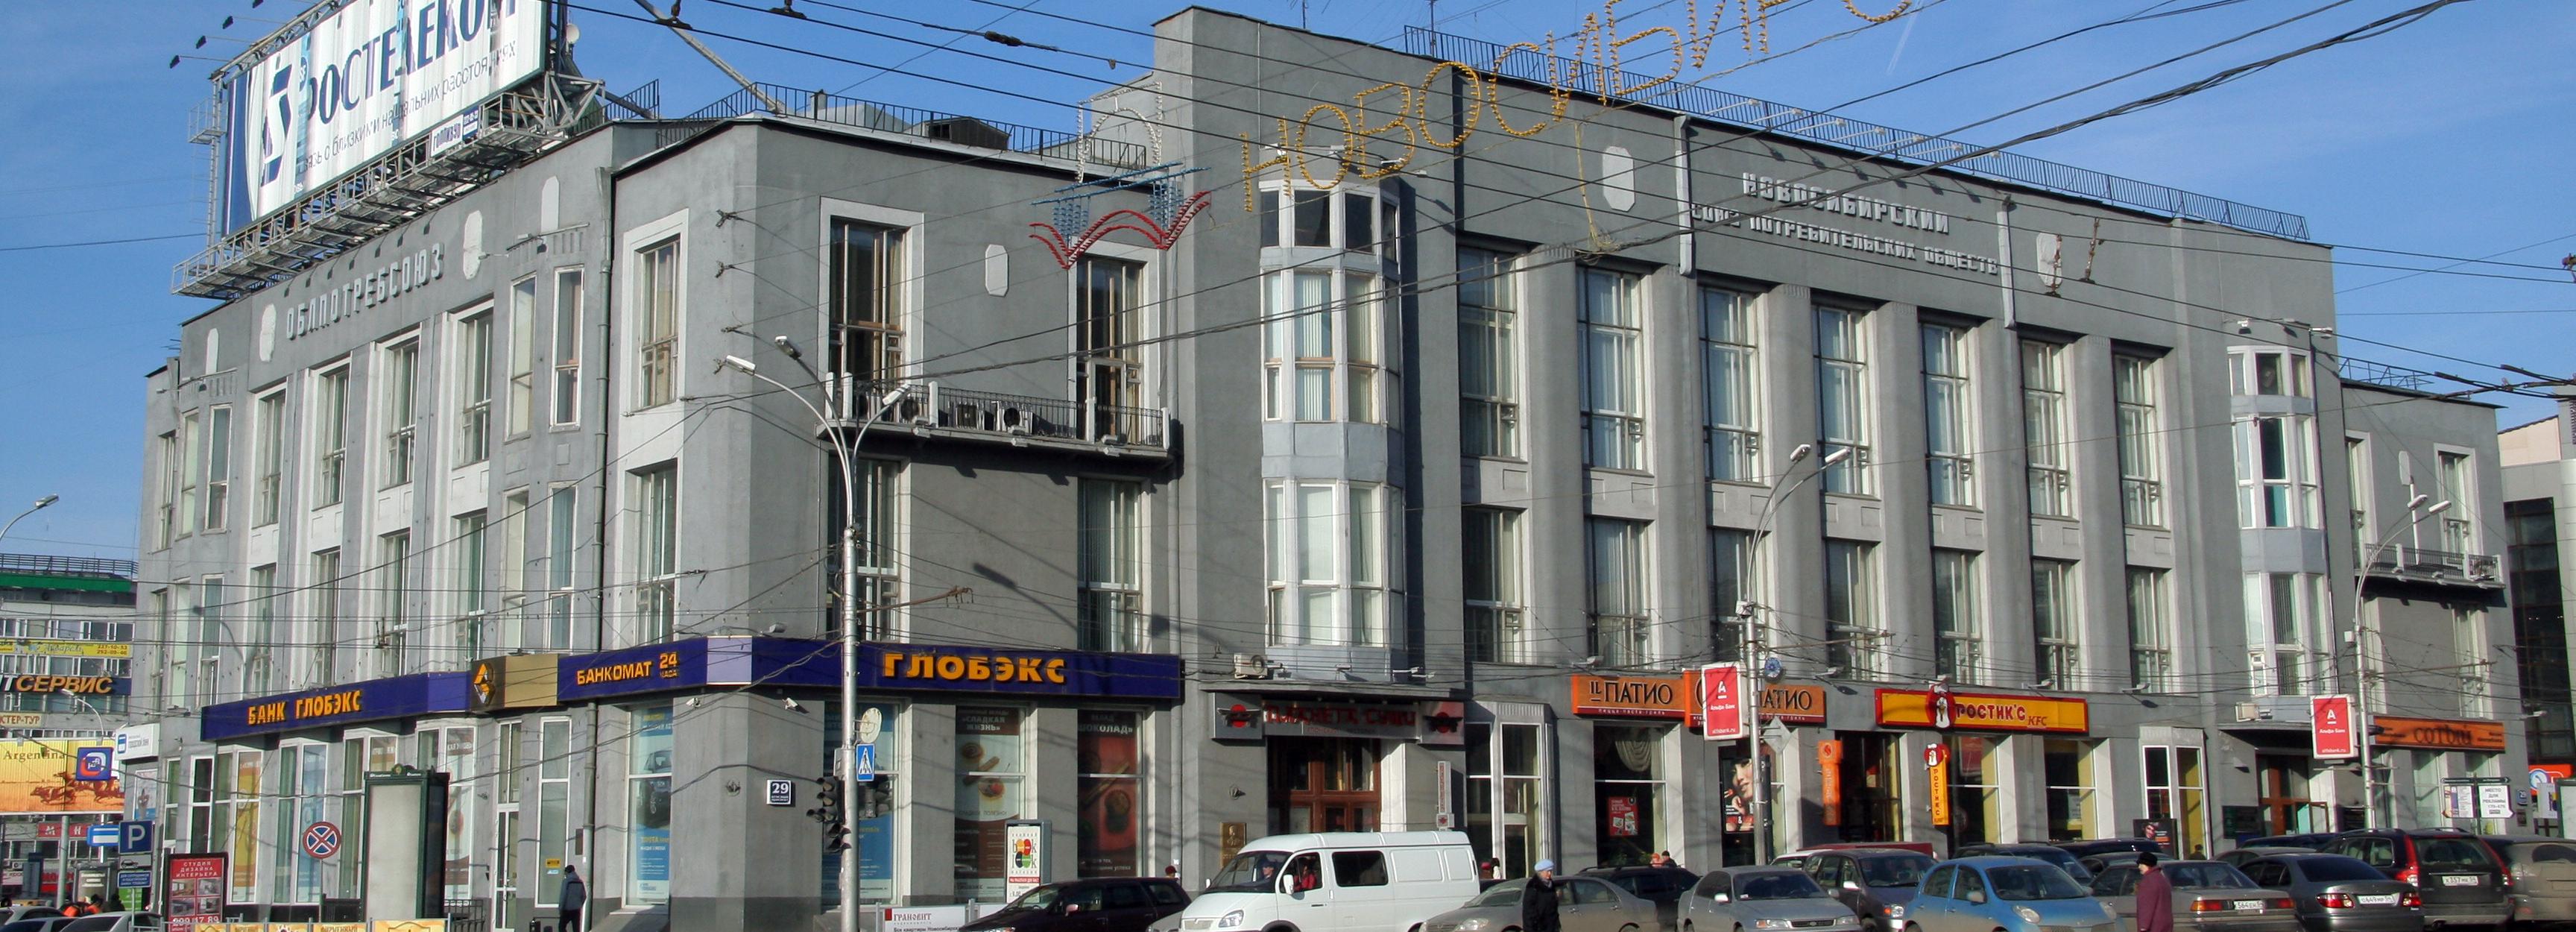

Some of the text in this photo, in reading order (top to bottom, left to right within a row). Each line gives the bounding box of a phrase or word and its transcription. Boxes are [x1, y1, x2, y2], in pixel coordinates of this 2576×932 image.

[1750, 215, 1916, 260] ПОТРЕБИТЕЛЬСКИХ
[1925, 246, 1998, 275] ОБЩЕСТВ
[287, 243, 442, 339] ОБЛПОТРЕБСОЮЗ
[577, 652, 678, 684] БАНКОМАТ 24
[883, 652, 1066, 684] ГЛОБЭКС
[1605, 679, 1673, 705] ПАТИО
[1760, 687, 1812, 711] АТИО
[248, 690, 362, 725] БАНК ГЛОБЭКС
[2027, 716, 2048, 726] KFC
[772, 783, 789, 794] 29
[127, 825, 145, 849] P
